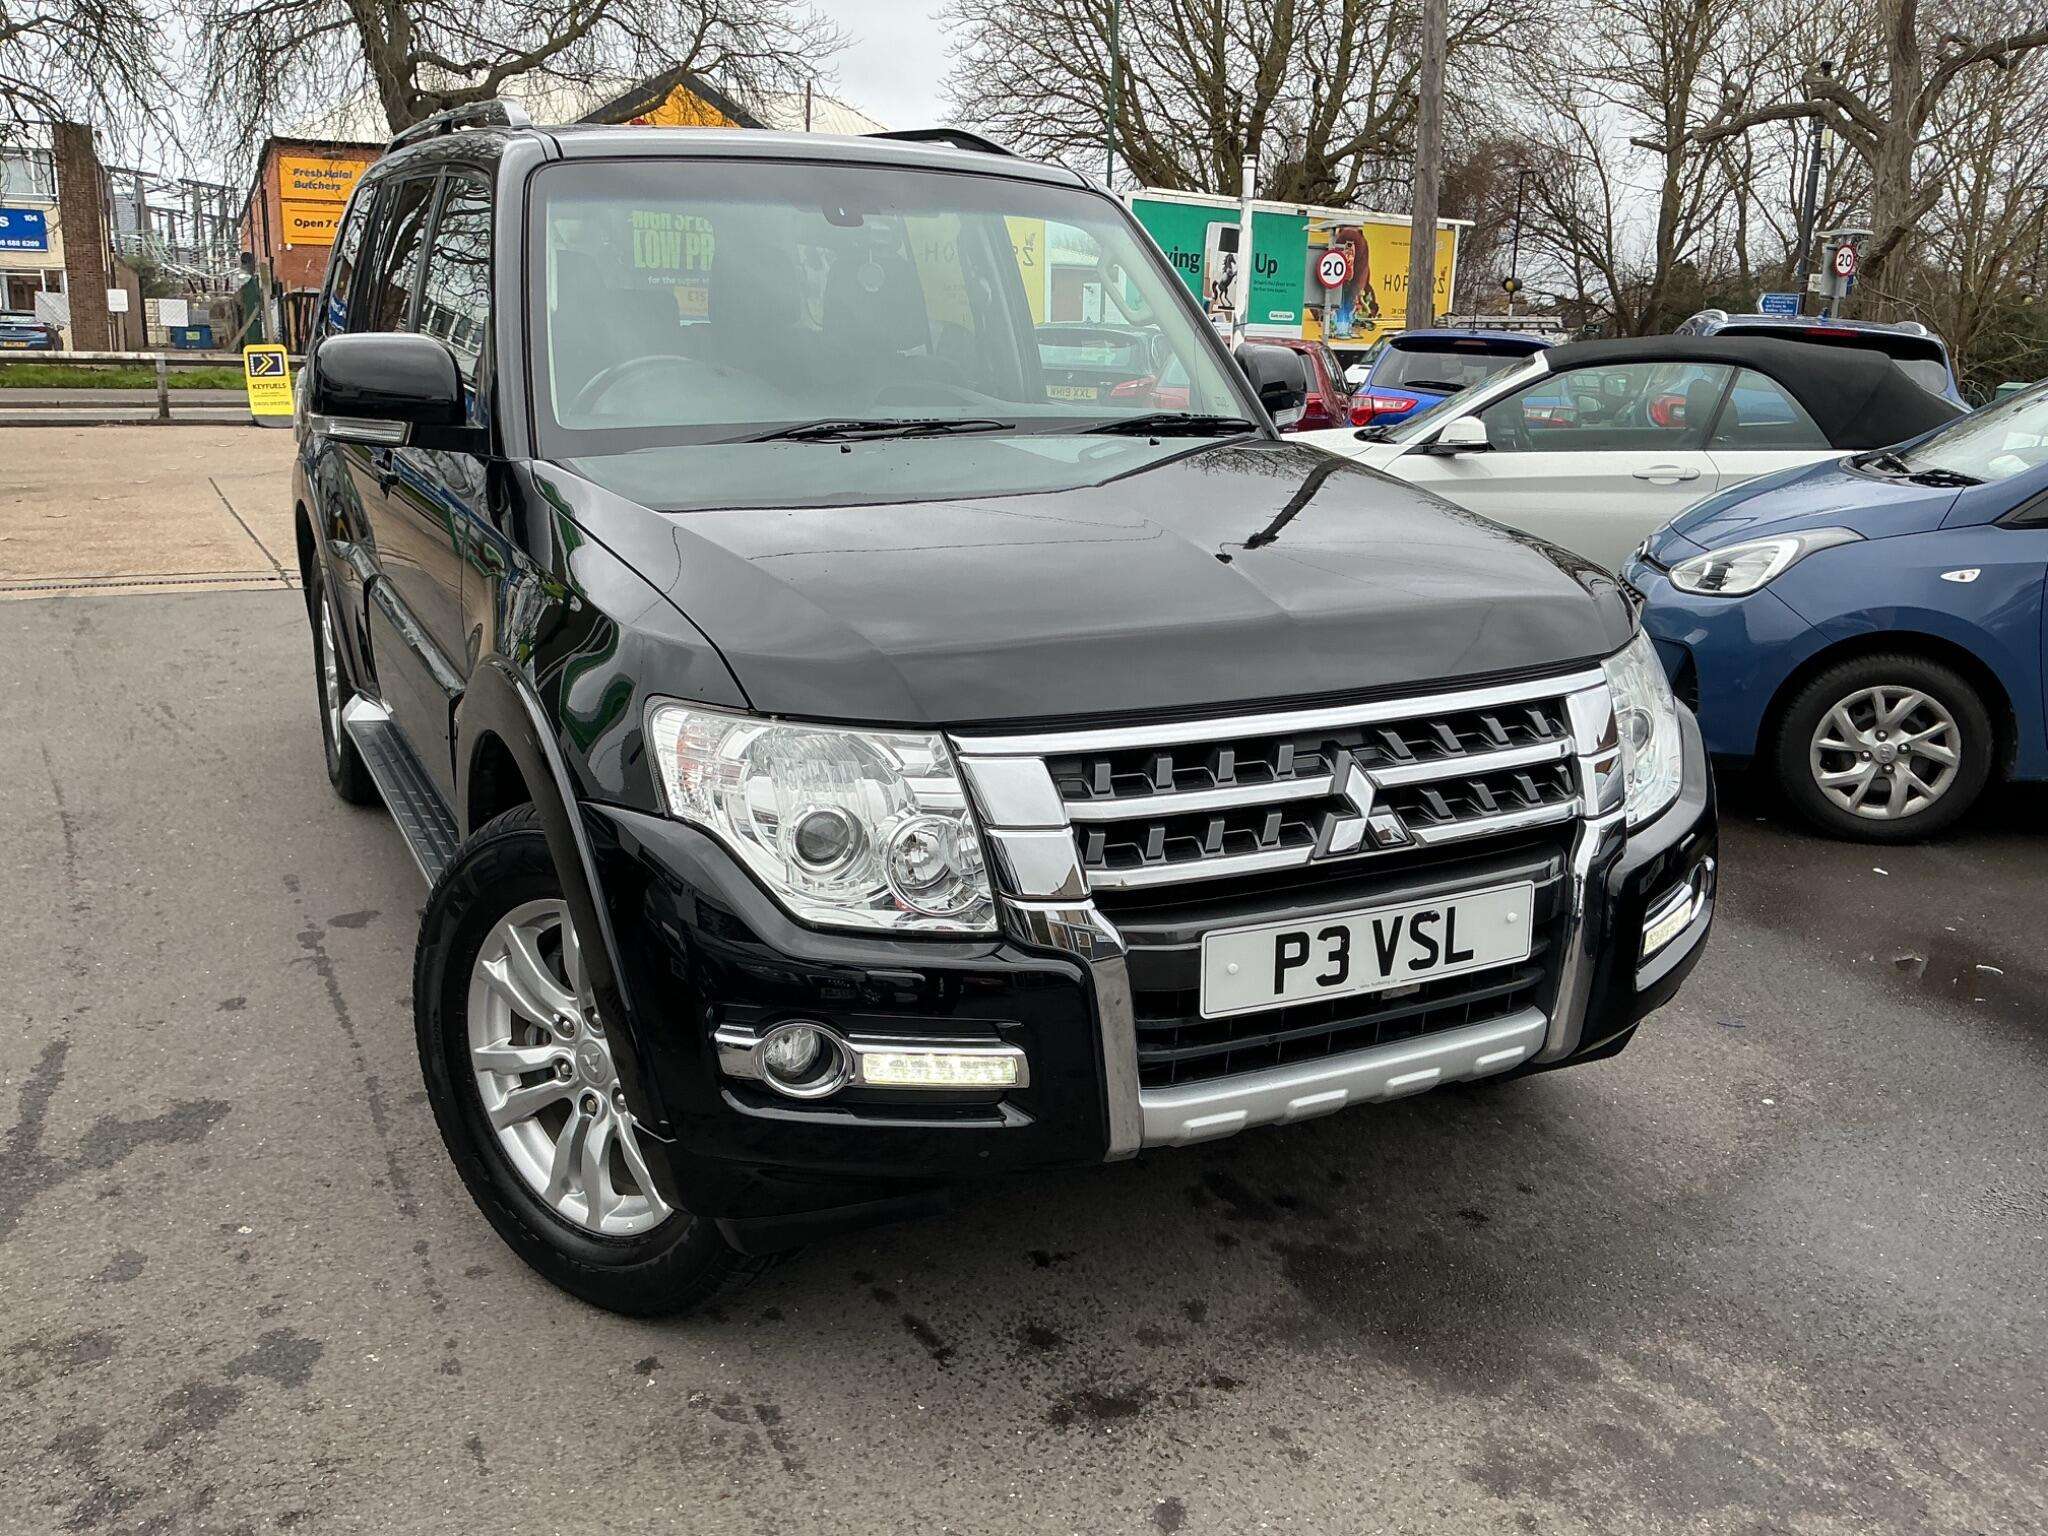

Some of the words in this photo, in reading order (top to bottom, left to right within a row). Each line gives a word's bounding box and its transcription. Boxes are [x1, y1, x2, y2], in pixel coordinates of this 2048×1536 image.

[293, 168, 322, 178] Fresh
[325, 168, 352, 179] Halal
[293, 180, 341, 190] Butchers
[23, 214, 38, 222] 104
[293, 218, 324, 229] Open
[325, 219, 331, 228] 7
[633, 228, 681, 269] LOW
[1254, 253, 1278, 278] Up
[1838, 253, 1852, 267] 20
[1322, 261, 1344, 277] 20
[252, 382, 287, 390] KEYFUELS
[1274, 925, 1350, 995] P3
[1372, 906, 1474, 977] VSL
